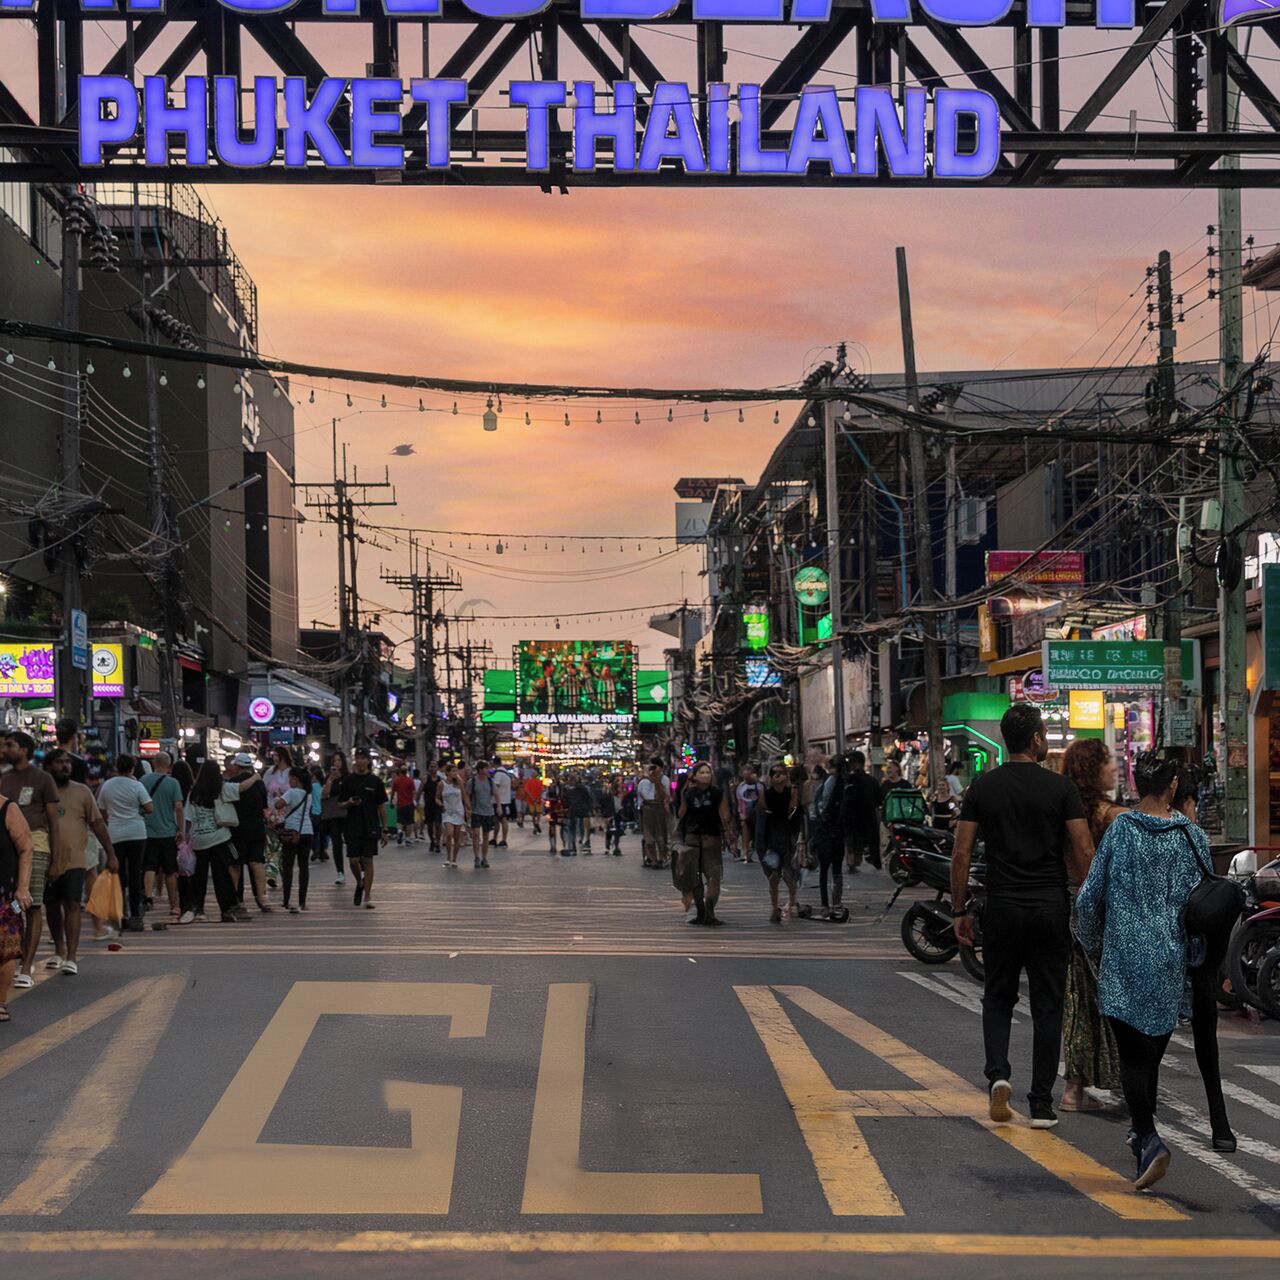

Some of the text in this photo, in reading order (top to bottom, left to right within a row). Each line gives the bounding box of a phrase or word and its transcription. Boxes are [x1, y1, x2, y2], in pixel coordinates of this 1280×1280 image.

[76, 74, 1004, 180] PHUKET THAILAND
[519, 713, 558, 723] BANGLA
[558, 713, 600, 723] WALKING
